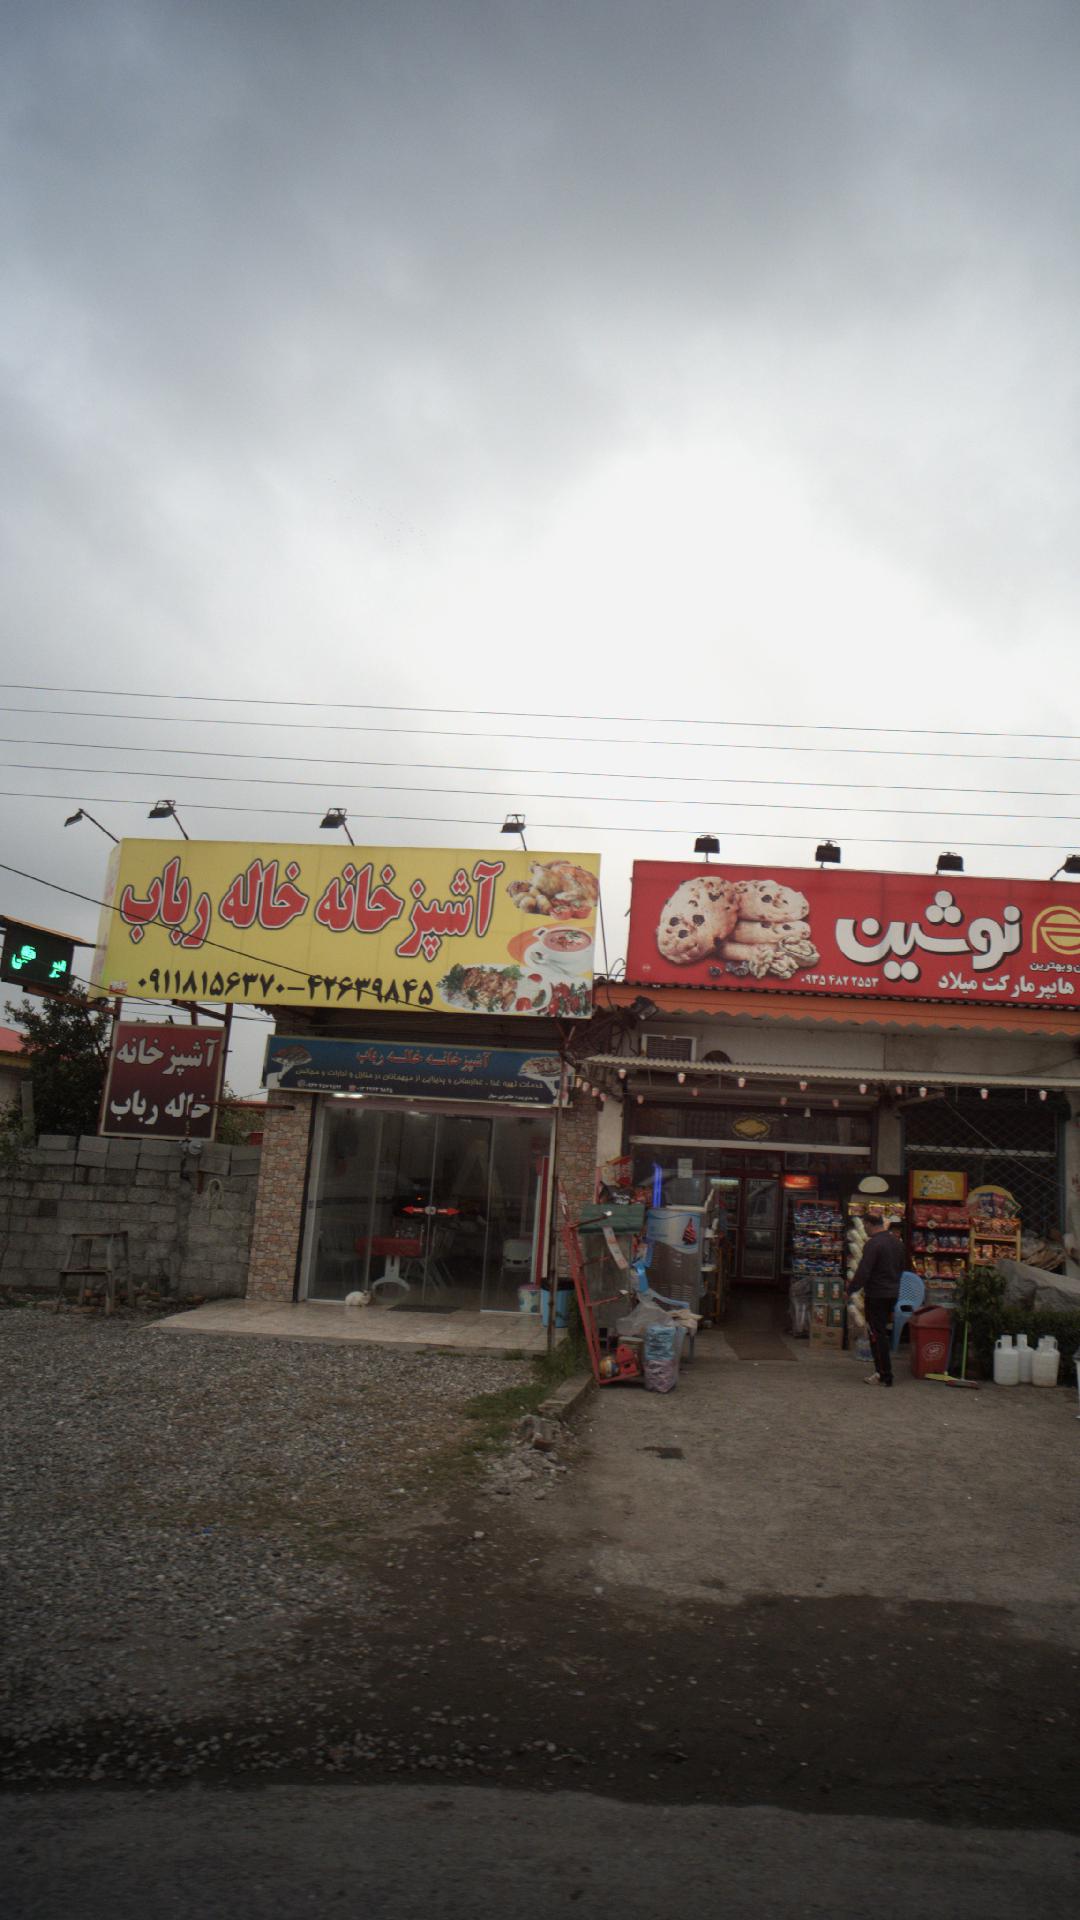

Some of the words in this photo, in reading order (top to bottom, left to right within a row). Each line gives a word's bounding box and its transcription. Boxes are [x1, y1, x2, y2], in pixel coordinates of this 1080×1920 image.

[121, 856, 212, 948] رباب
[219, 858, 309, 930] خاله
[835, 890, 1021, 981] نوشین
[938, 971, 978, 994] میلاد
[110, 1090, 158, 1125] رباب
[164, 1091, 210, 1118] خاله
